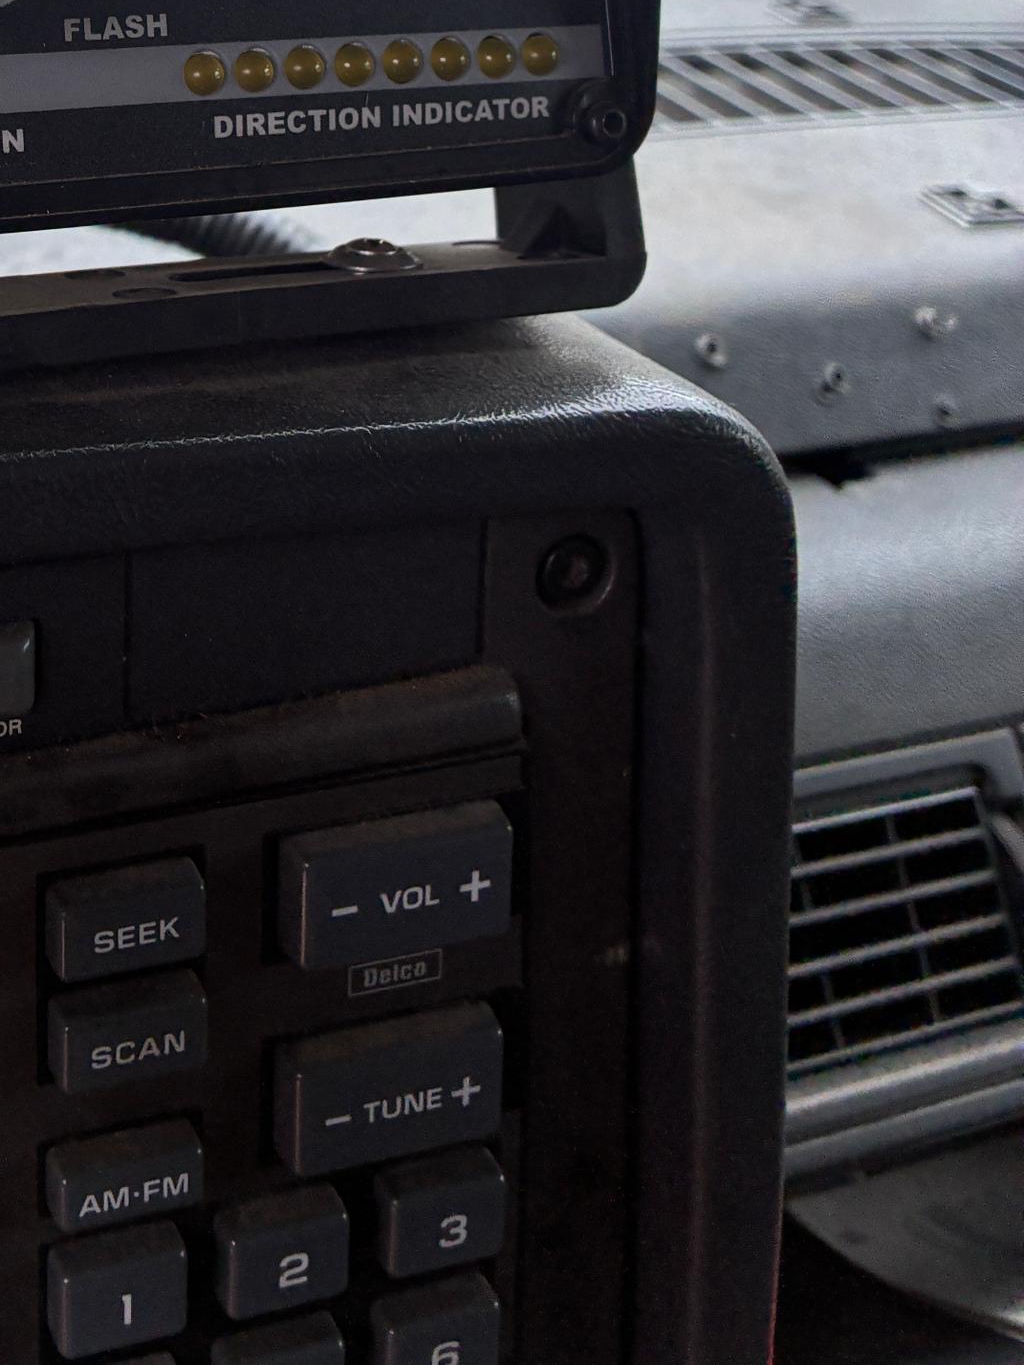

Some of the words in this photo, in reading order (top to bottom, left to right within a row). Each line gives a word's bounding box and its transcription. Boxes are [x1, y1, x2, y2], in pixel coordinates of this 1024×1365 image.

[63, 13, 169, 42] FLASH
[213, 105, 382, 139] DIRECTION
[392, 95, 551, 127] INDICATOR
[380, 884, 440, 915] VOL
[93, 916, 180, 955] SEEK
[90, 1030, 187, 1070] SCAN
[363, 1087, 442, 1122] TUNE
[438, 1214, 469, 1249] 3
[278, 1252, 310, 1289] 2
[120, 1294, 132, 1326] 1
